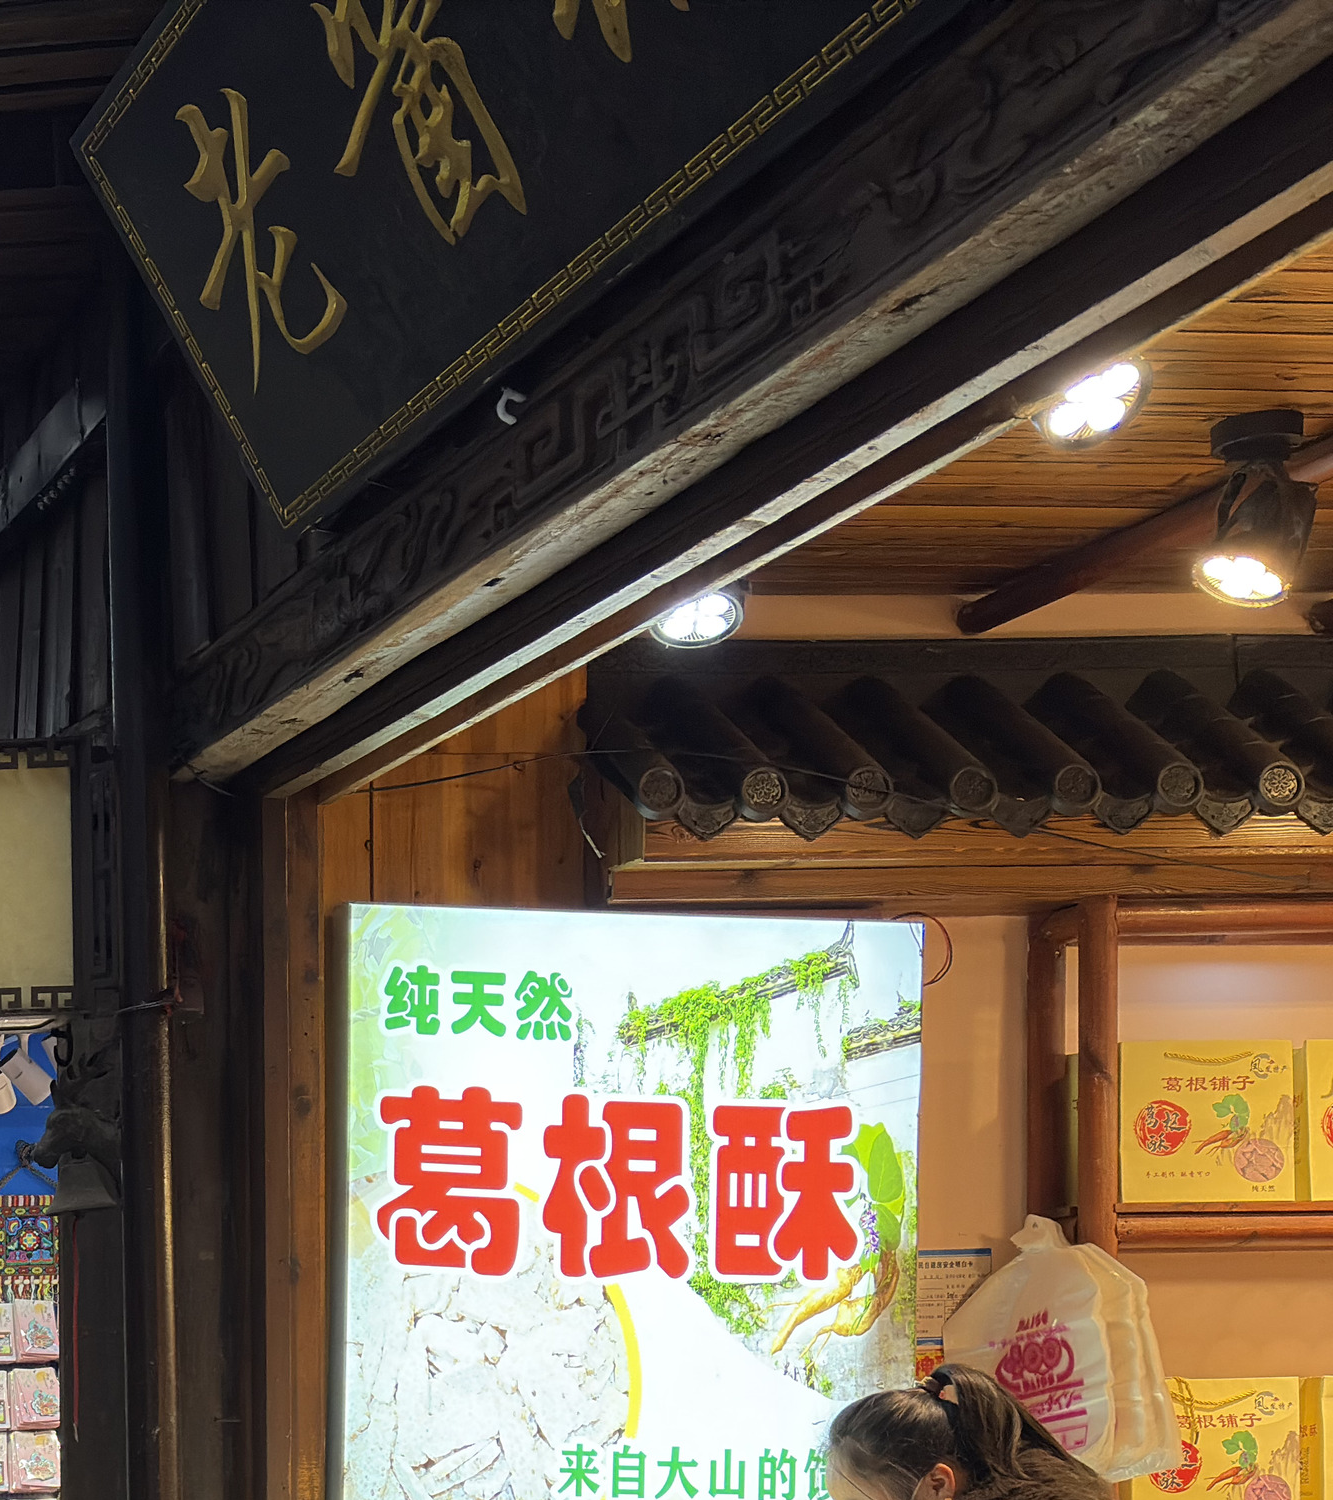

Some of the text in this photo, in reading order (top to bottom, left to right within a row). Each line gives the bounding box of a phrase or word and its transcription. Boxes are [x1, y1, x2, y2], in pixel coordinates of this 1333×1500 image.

[383, 964, 573, 1042] 纯天然
[1161, 1075, 1255, 1093] 葛根铺子
[1147, 1132, 1170, 1152] 酥
[377, 1085, 859, 1282] 葛根酥
[1252, 1185, 1276, 1193] 纯天然
